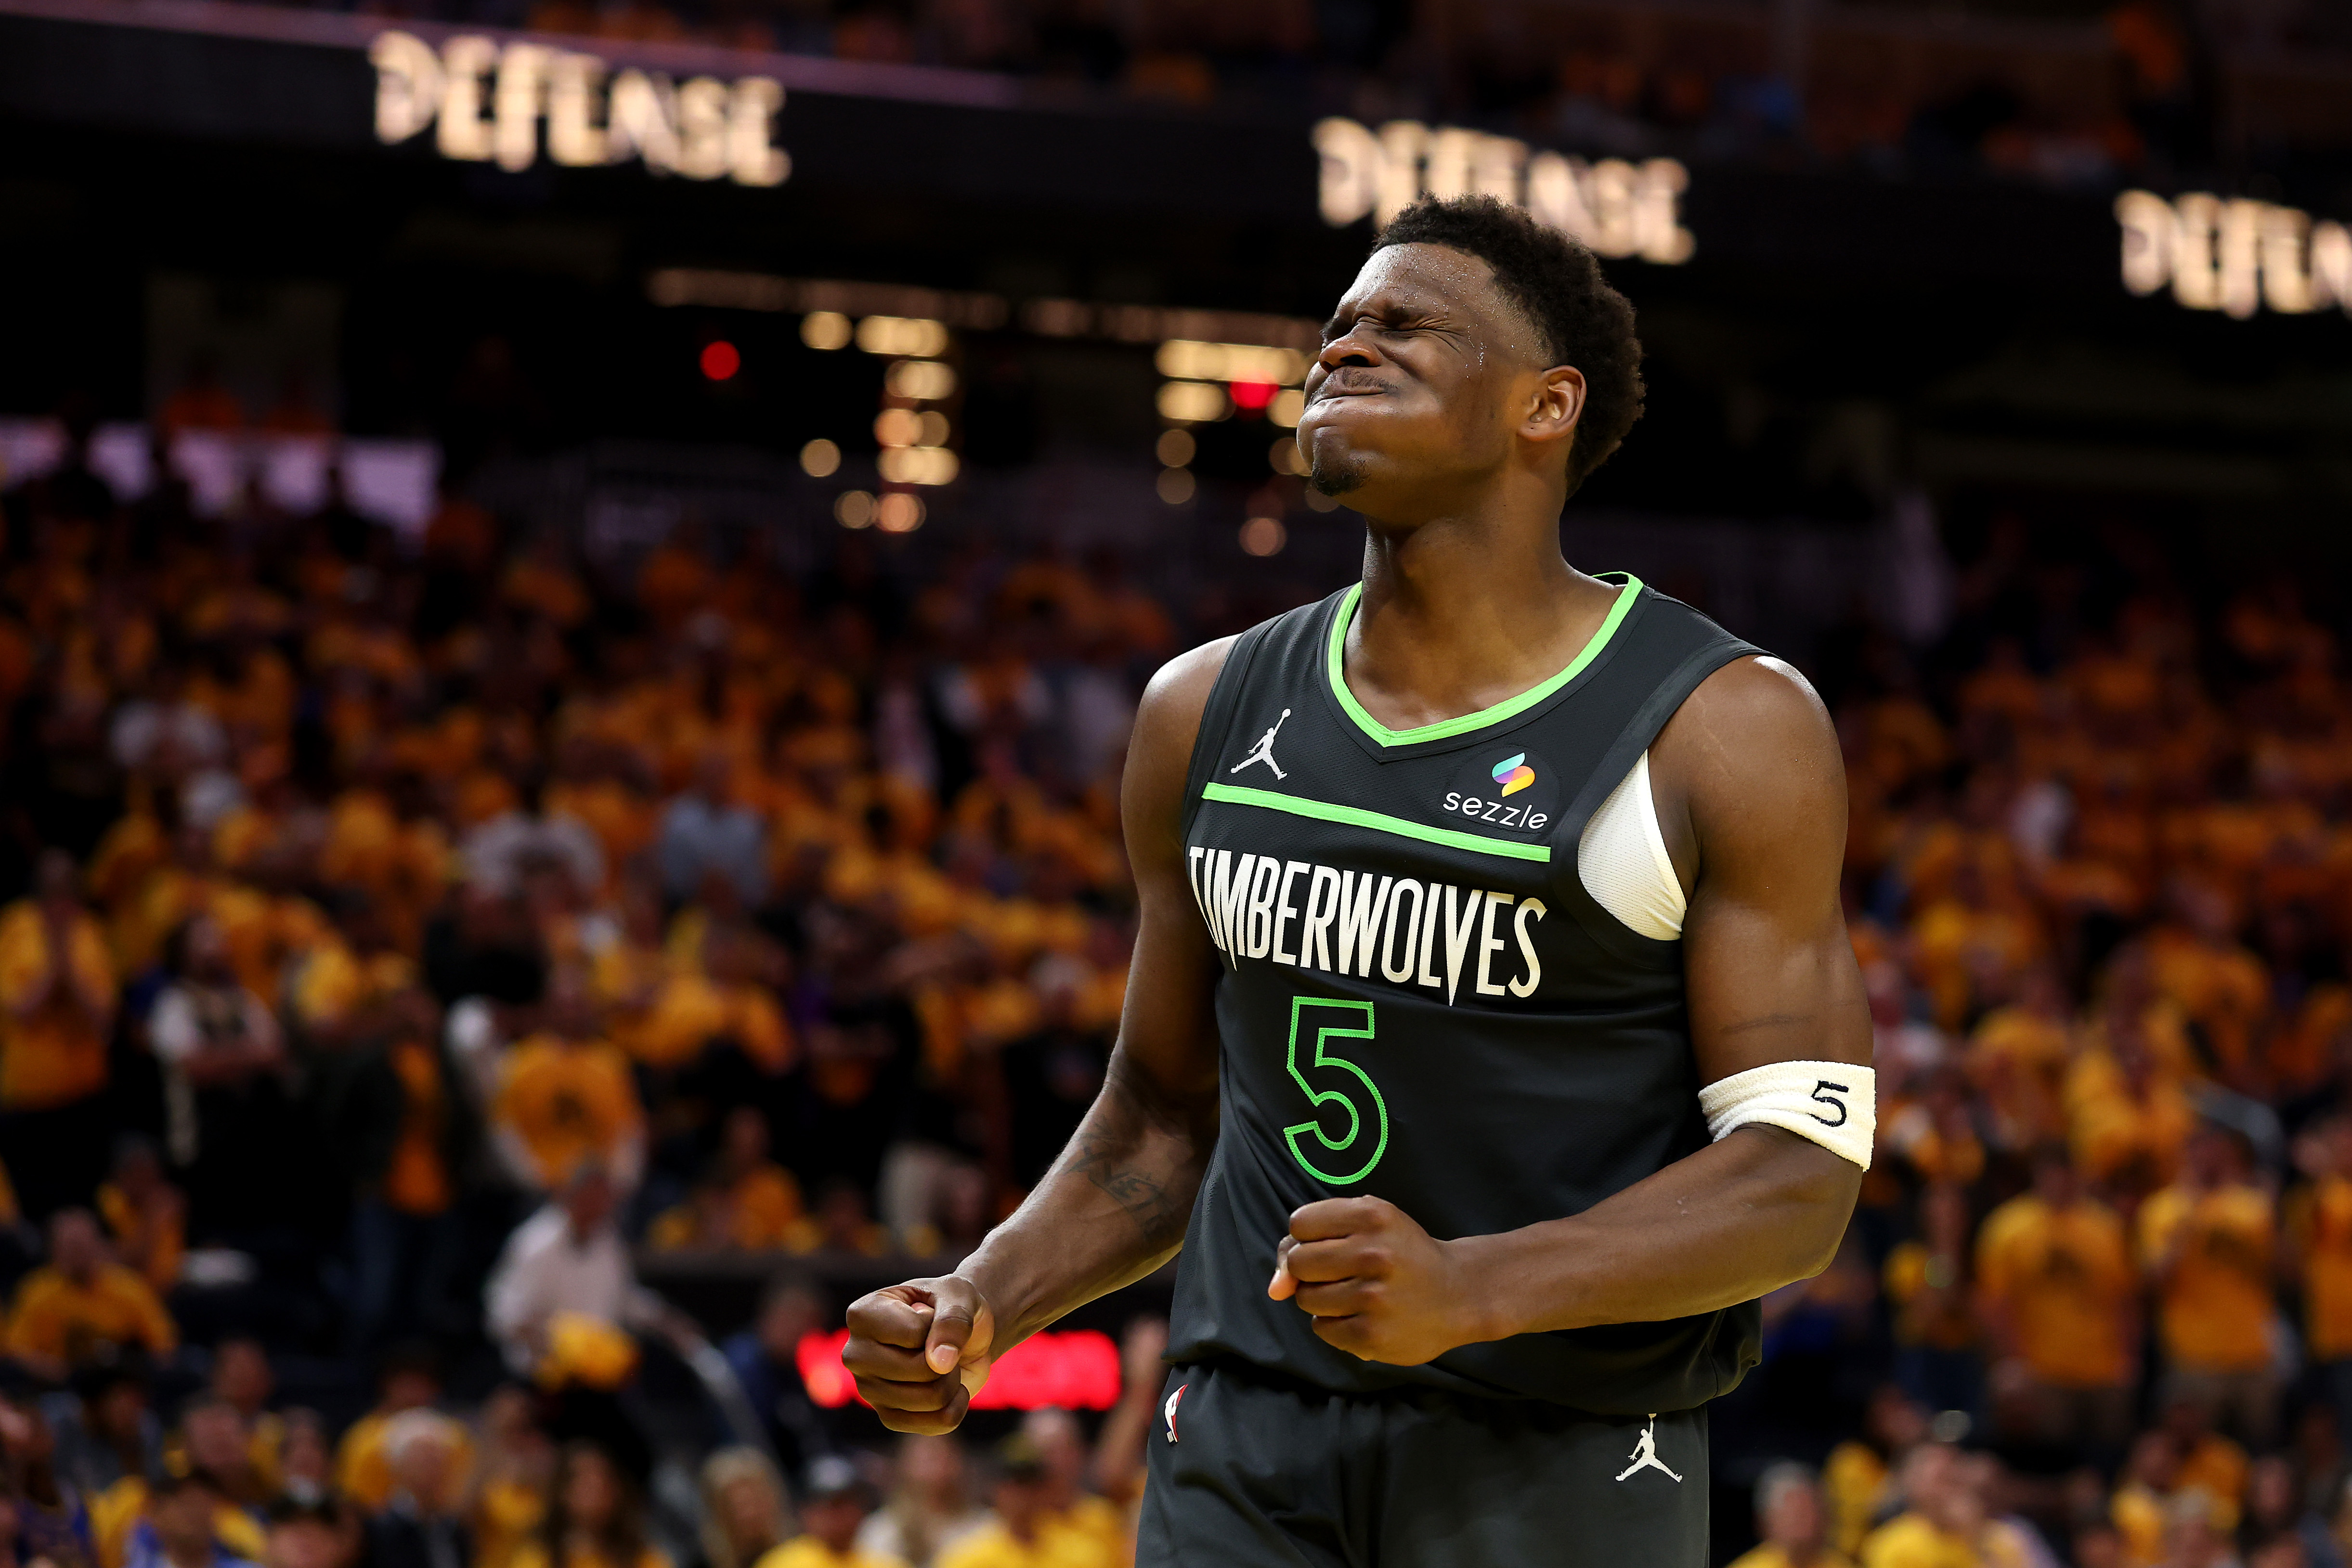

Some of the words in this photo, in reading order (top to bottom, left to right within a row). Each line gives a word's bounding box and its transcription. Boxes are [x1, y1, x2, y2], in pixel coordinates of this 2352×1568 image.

[370, 32, 791, 186] DEFENSE
[1443, 792, 1548, 829] sezzle
[1189, 846, 1547, 1007] TIMBERWOLVES
[1283, 996, 1388, 1185] 5
[1807, 1080, 1849, 1127] 5
